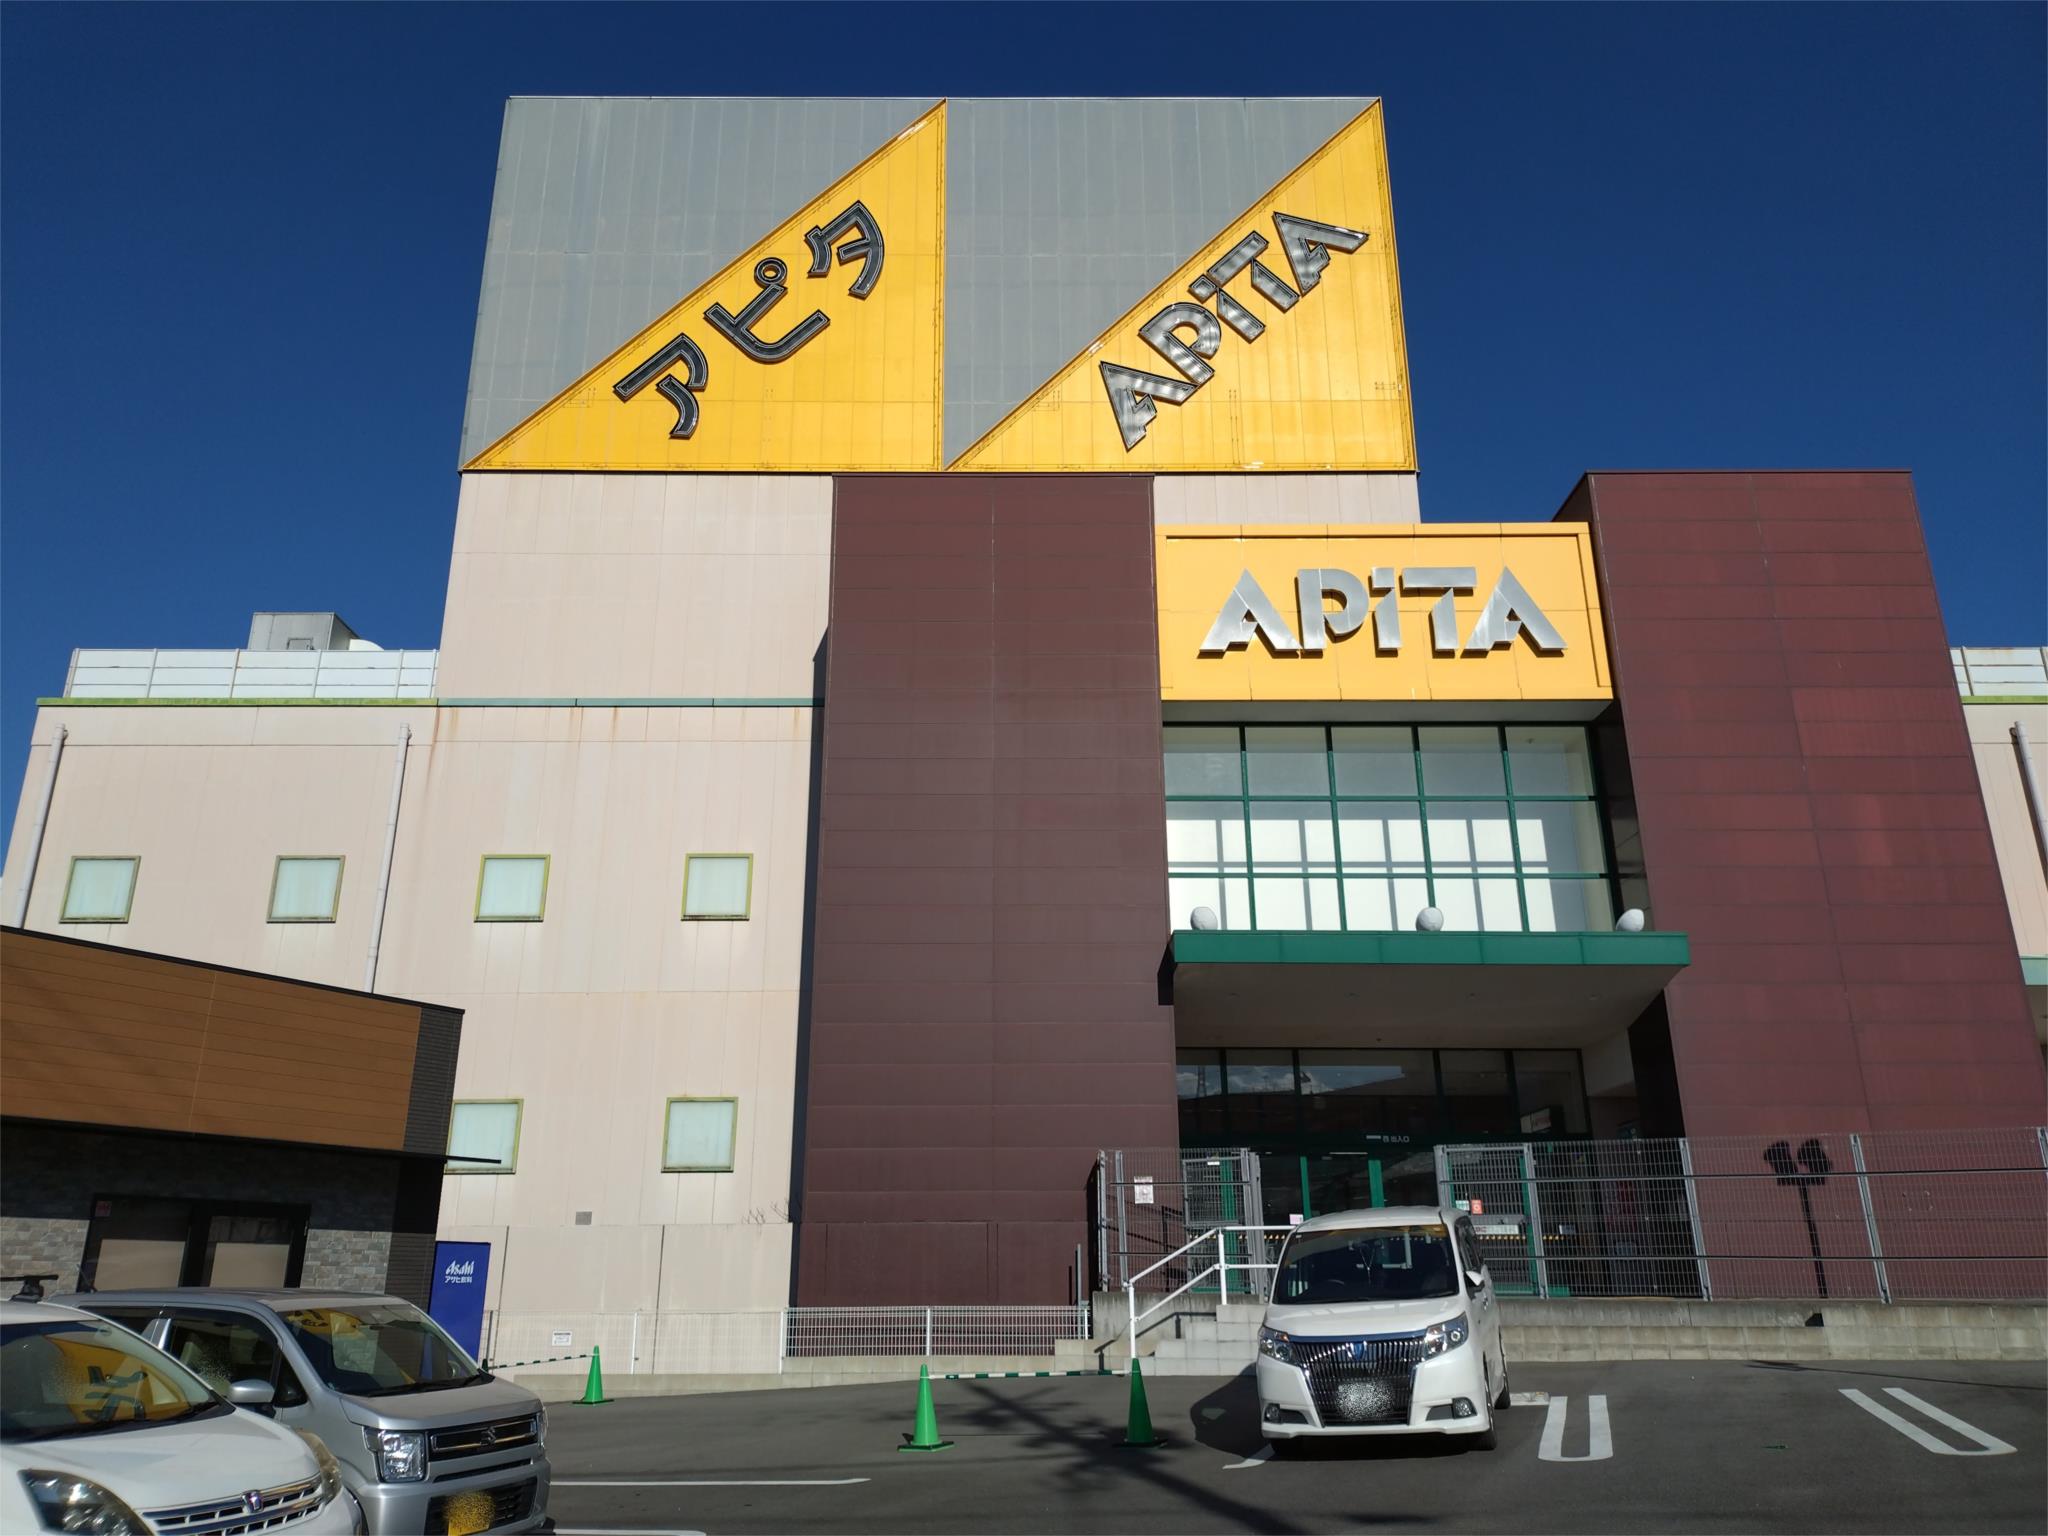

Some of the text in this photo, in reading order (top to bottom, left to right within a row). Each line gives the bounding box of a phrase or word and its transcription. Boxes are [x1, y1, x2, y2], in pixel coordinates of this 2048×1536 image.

[613, 200, 885, 440] アピタ
[445, 1260, 475, 1275] Asahi
